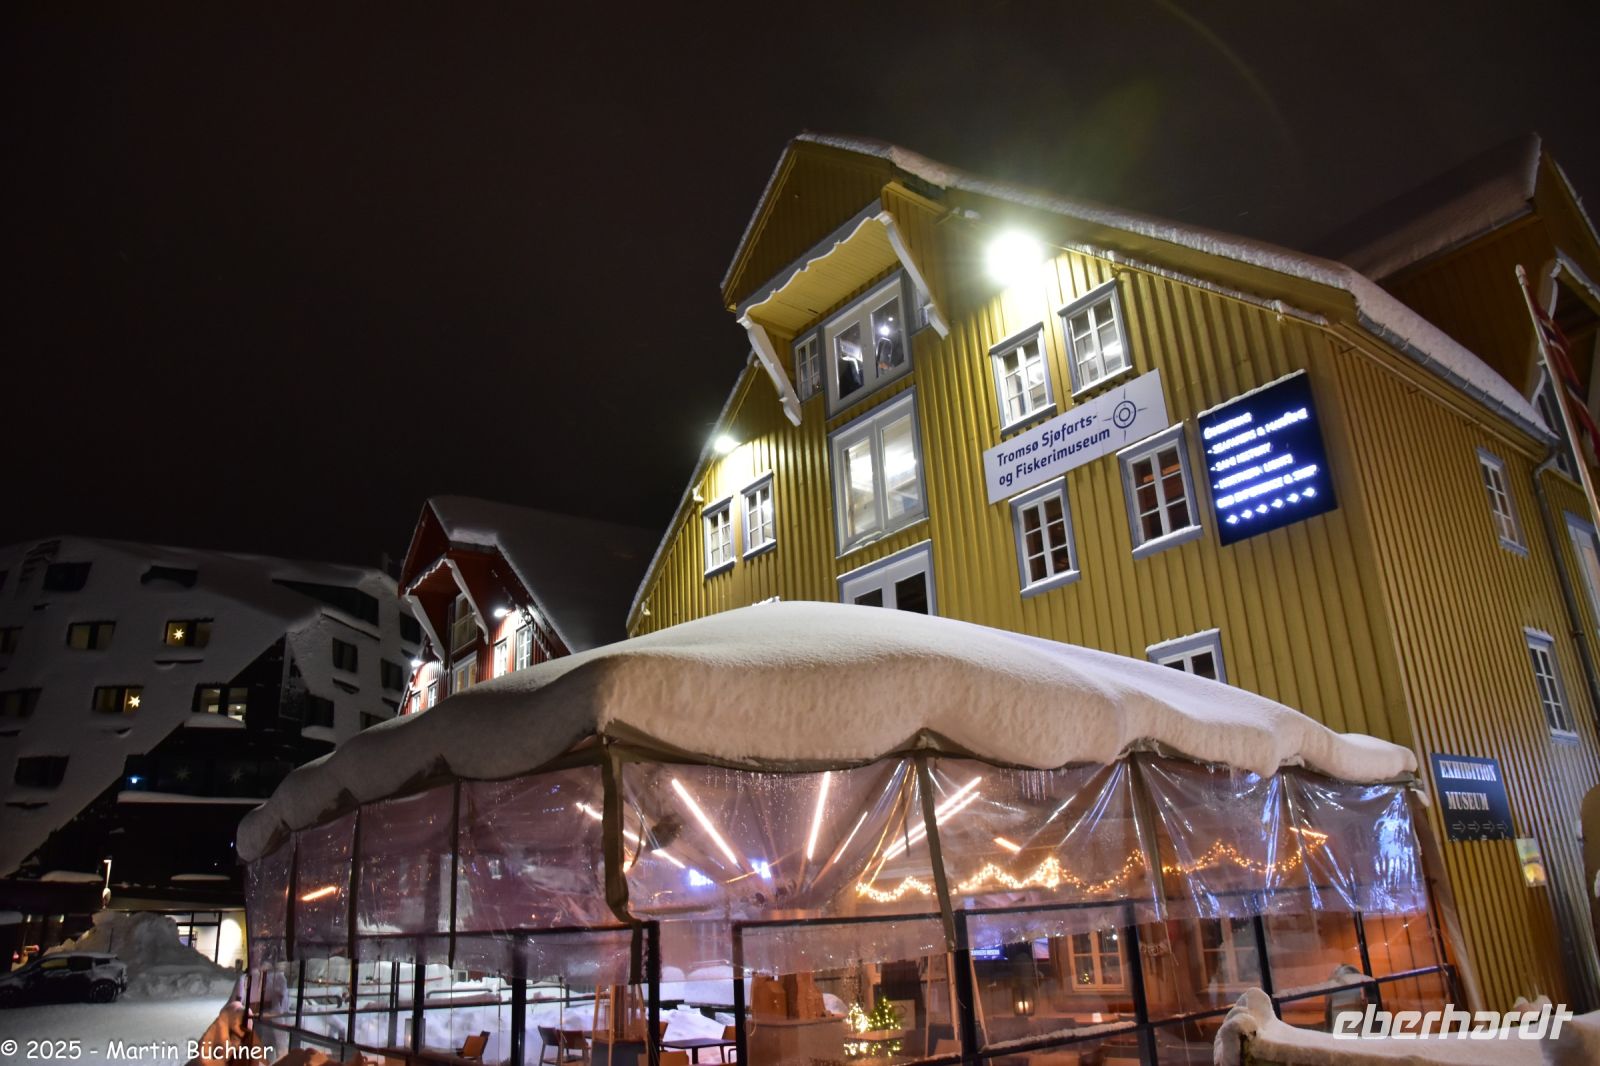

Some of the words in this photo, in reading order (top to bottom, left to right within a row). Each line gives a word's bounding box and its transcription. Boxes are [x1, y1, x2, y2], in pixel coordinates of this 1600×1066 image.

[996, 440, 1039, 467] Tromsø
[1041, 414, 1098, 448] Sjøfarts-
[999, 471, 1013, 487] og
[1016, 428, 1111, 479] Fiskerimuseum
[1439, 759, 1497, 782] EXHIBITION
[1445, 791, 1490, 811] MUSEUM
